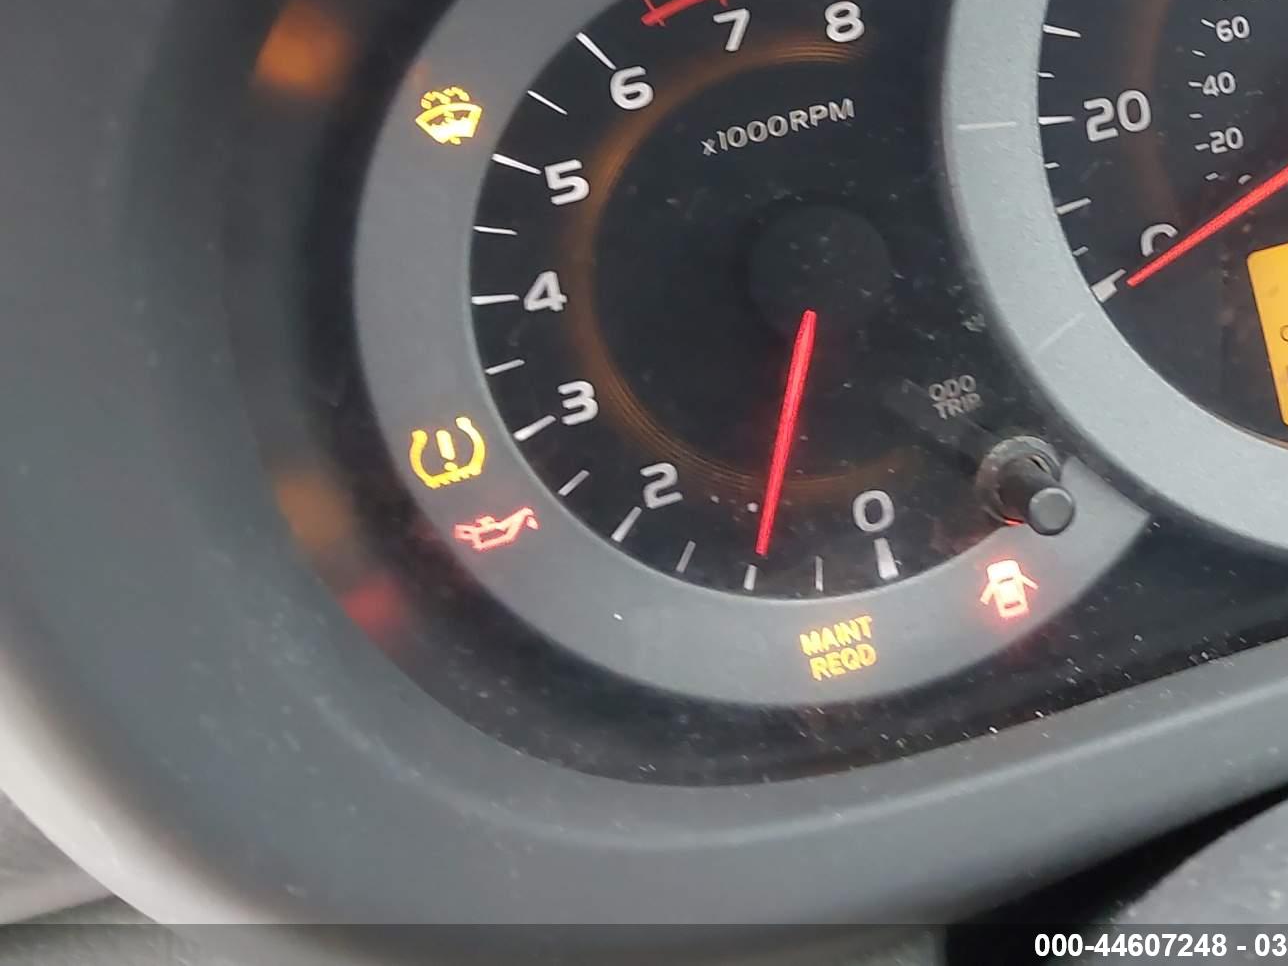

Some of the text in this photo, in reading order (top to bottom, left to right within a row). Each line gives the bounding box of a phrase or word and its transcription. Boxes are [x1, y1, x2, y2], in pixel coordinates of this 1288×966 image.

[713, 8, 750, 51] 7
[825, 1, 865, 43] 8
[1215, 16, 1250, 42] 60
[609, 65, 655, 111] 6
[1202, 71, 1236, 96] 40
[1083, 90, 1151, 142] 20
[1208, 127, 1244, 153] 20
[544, 159, 590, 206] 5
[523, 270, 567, 313] 4
[557, 380, 599, 427] 3
[928, 374, 977, 402] ODO
[932, 393, 981, 420] TRIP
[640, 461, 684, 510] 2
[853, 489, 895, 534] 0
[799, 615, 873, 656] MAINT
[809, 643, 877, 681] REQD
